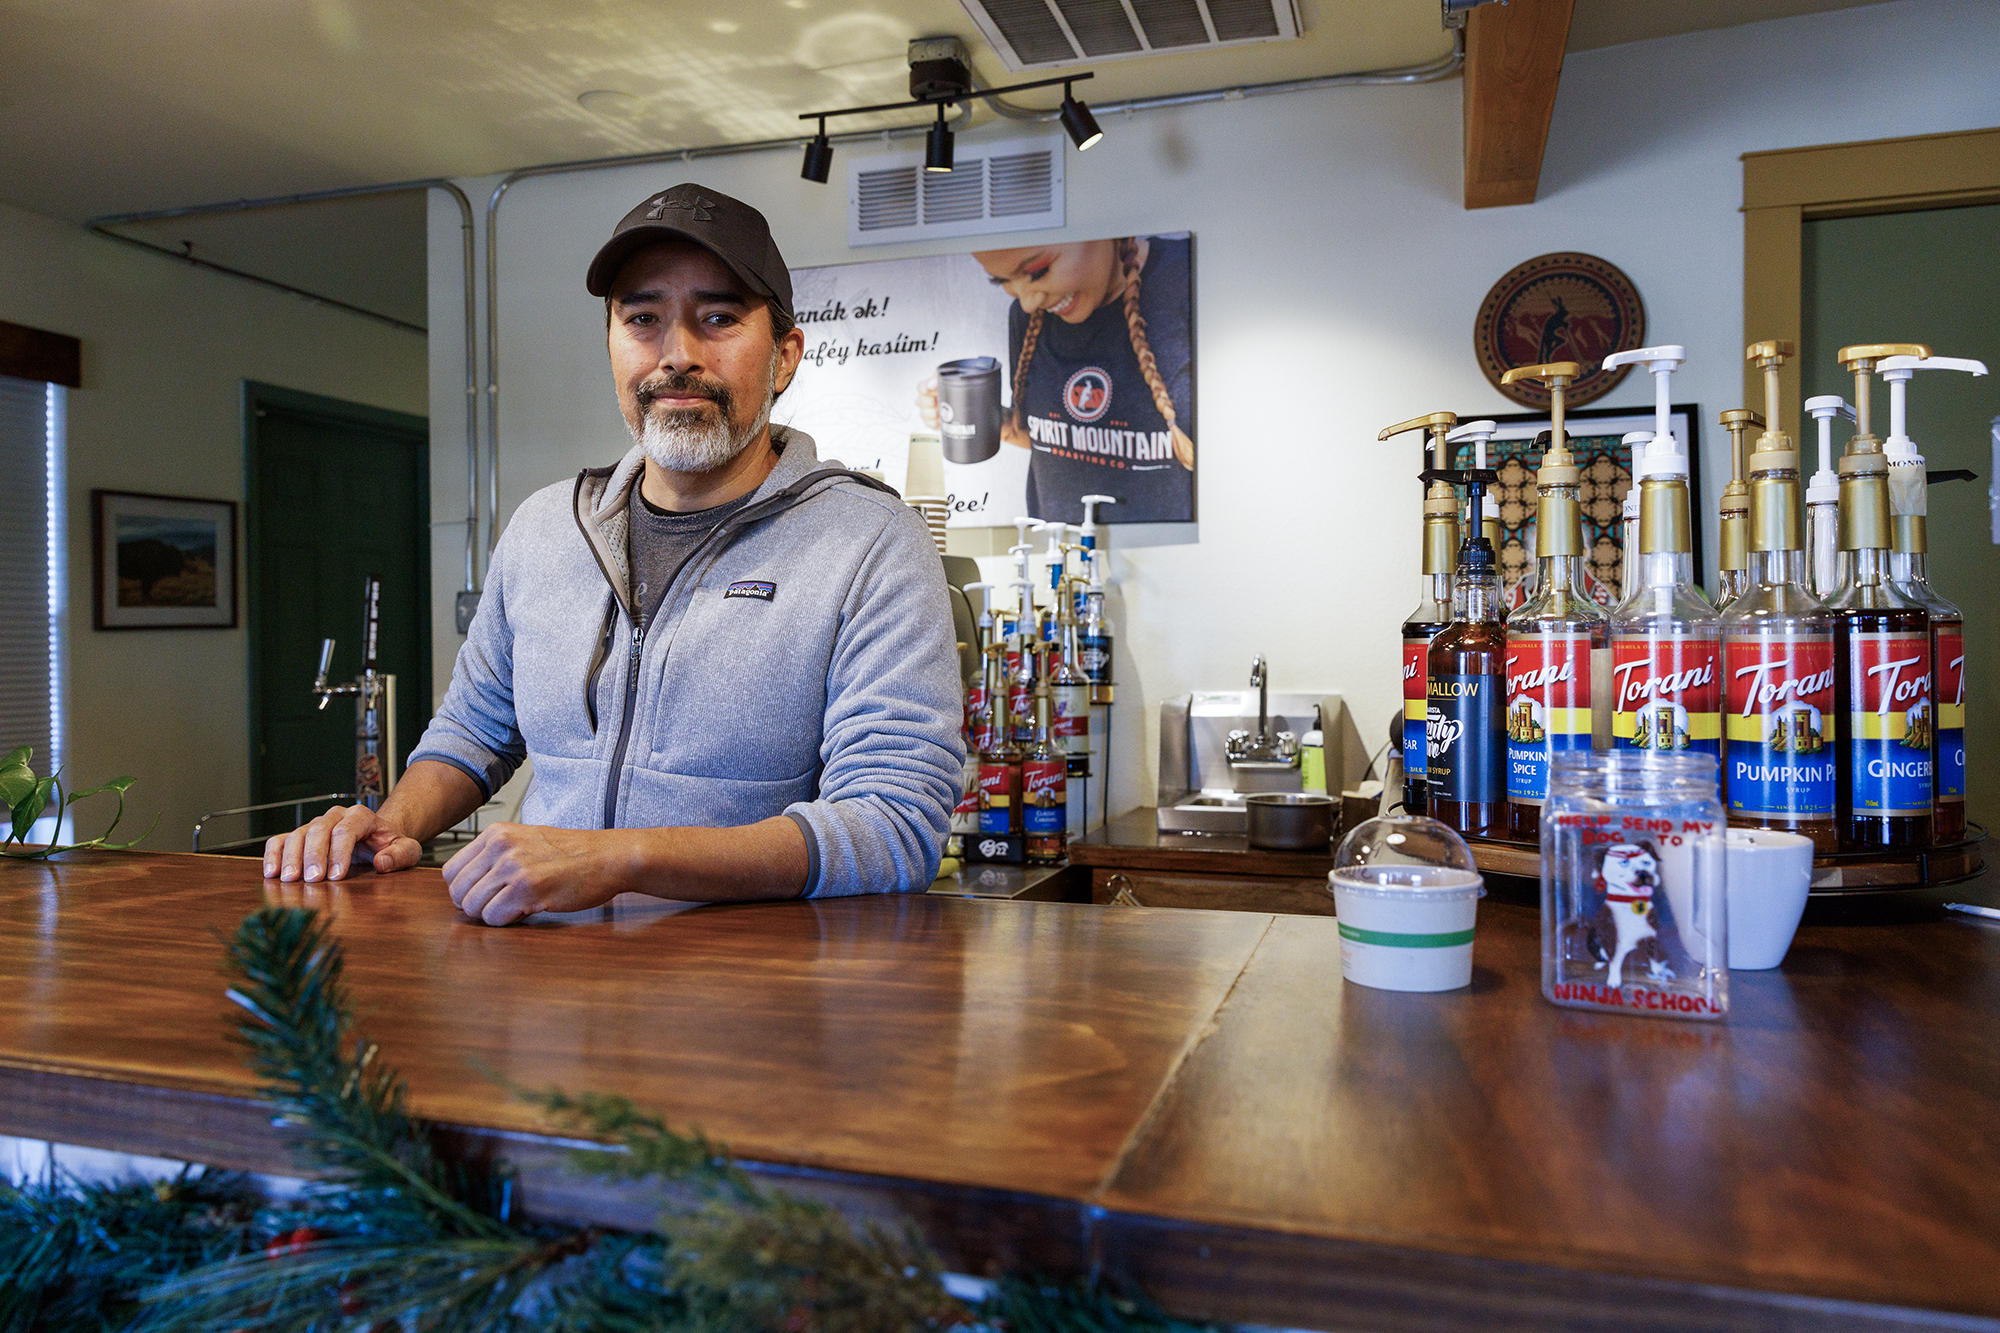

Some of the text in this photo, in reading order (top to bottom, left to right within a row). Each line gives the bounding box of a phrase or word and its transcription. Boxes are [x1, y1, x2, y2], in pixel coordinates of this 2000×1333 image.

[1027, 414, 1173, 460] SPIRIT MOUNTAIN
[1614, 655, 1713, 714] Torani
[1509, 747, 1548, 762] PUMPKIN
[1513, 762, 1537, 776] SPICE
[1736, 761, 1822, 783] PUMPKIN
[1559, 815, 1713, 835] HELP SEND MY
[1582, 829, 1683, 847] DOG TO
[1554, 983, 1721, 1014] NINJA SCHOOL
